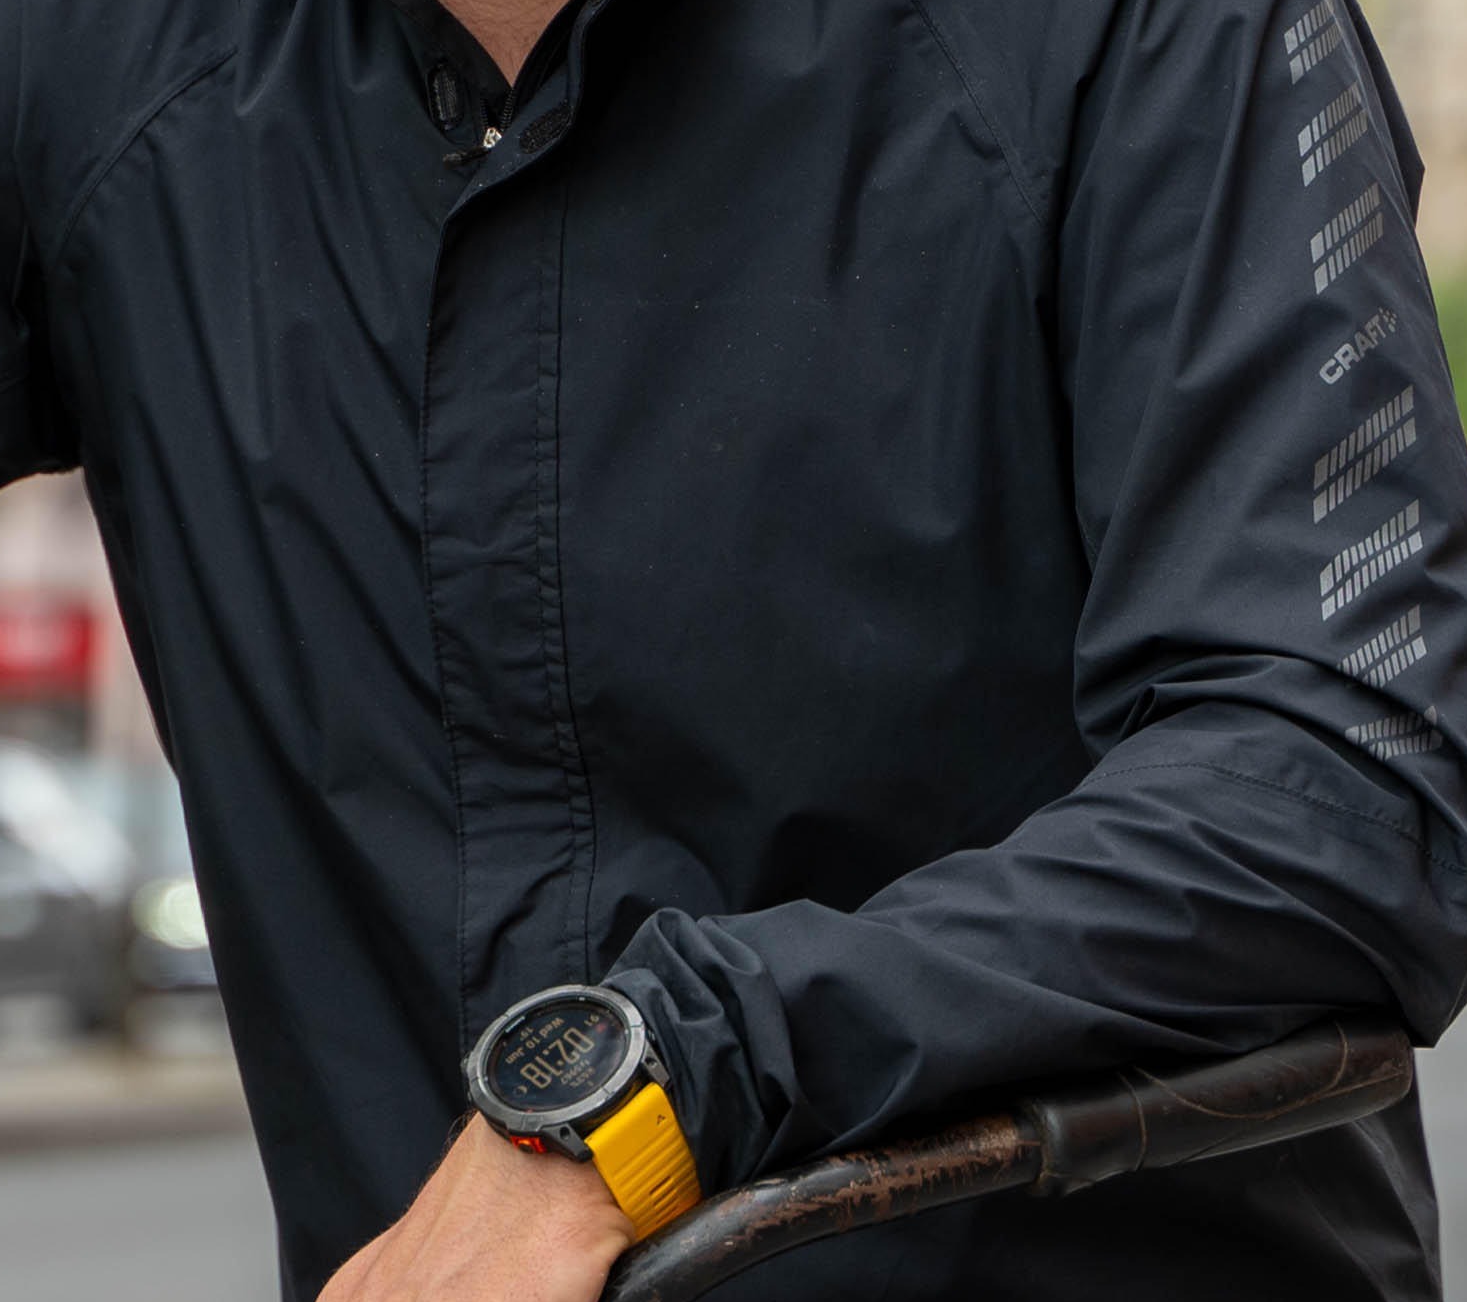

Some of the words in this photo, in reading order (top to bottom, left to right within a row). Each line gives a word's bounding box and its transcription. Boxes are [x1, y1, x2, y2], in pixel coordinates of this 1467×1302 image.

[1319, 314, 1387, 385] CRAFT
[539, 1017, 565, 1038] Wed
[505, 1046, 525, 1064] Jun
[520, 1028, 595, 1088] 02:18
